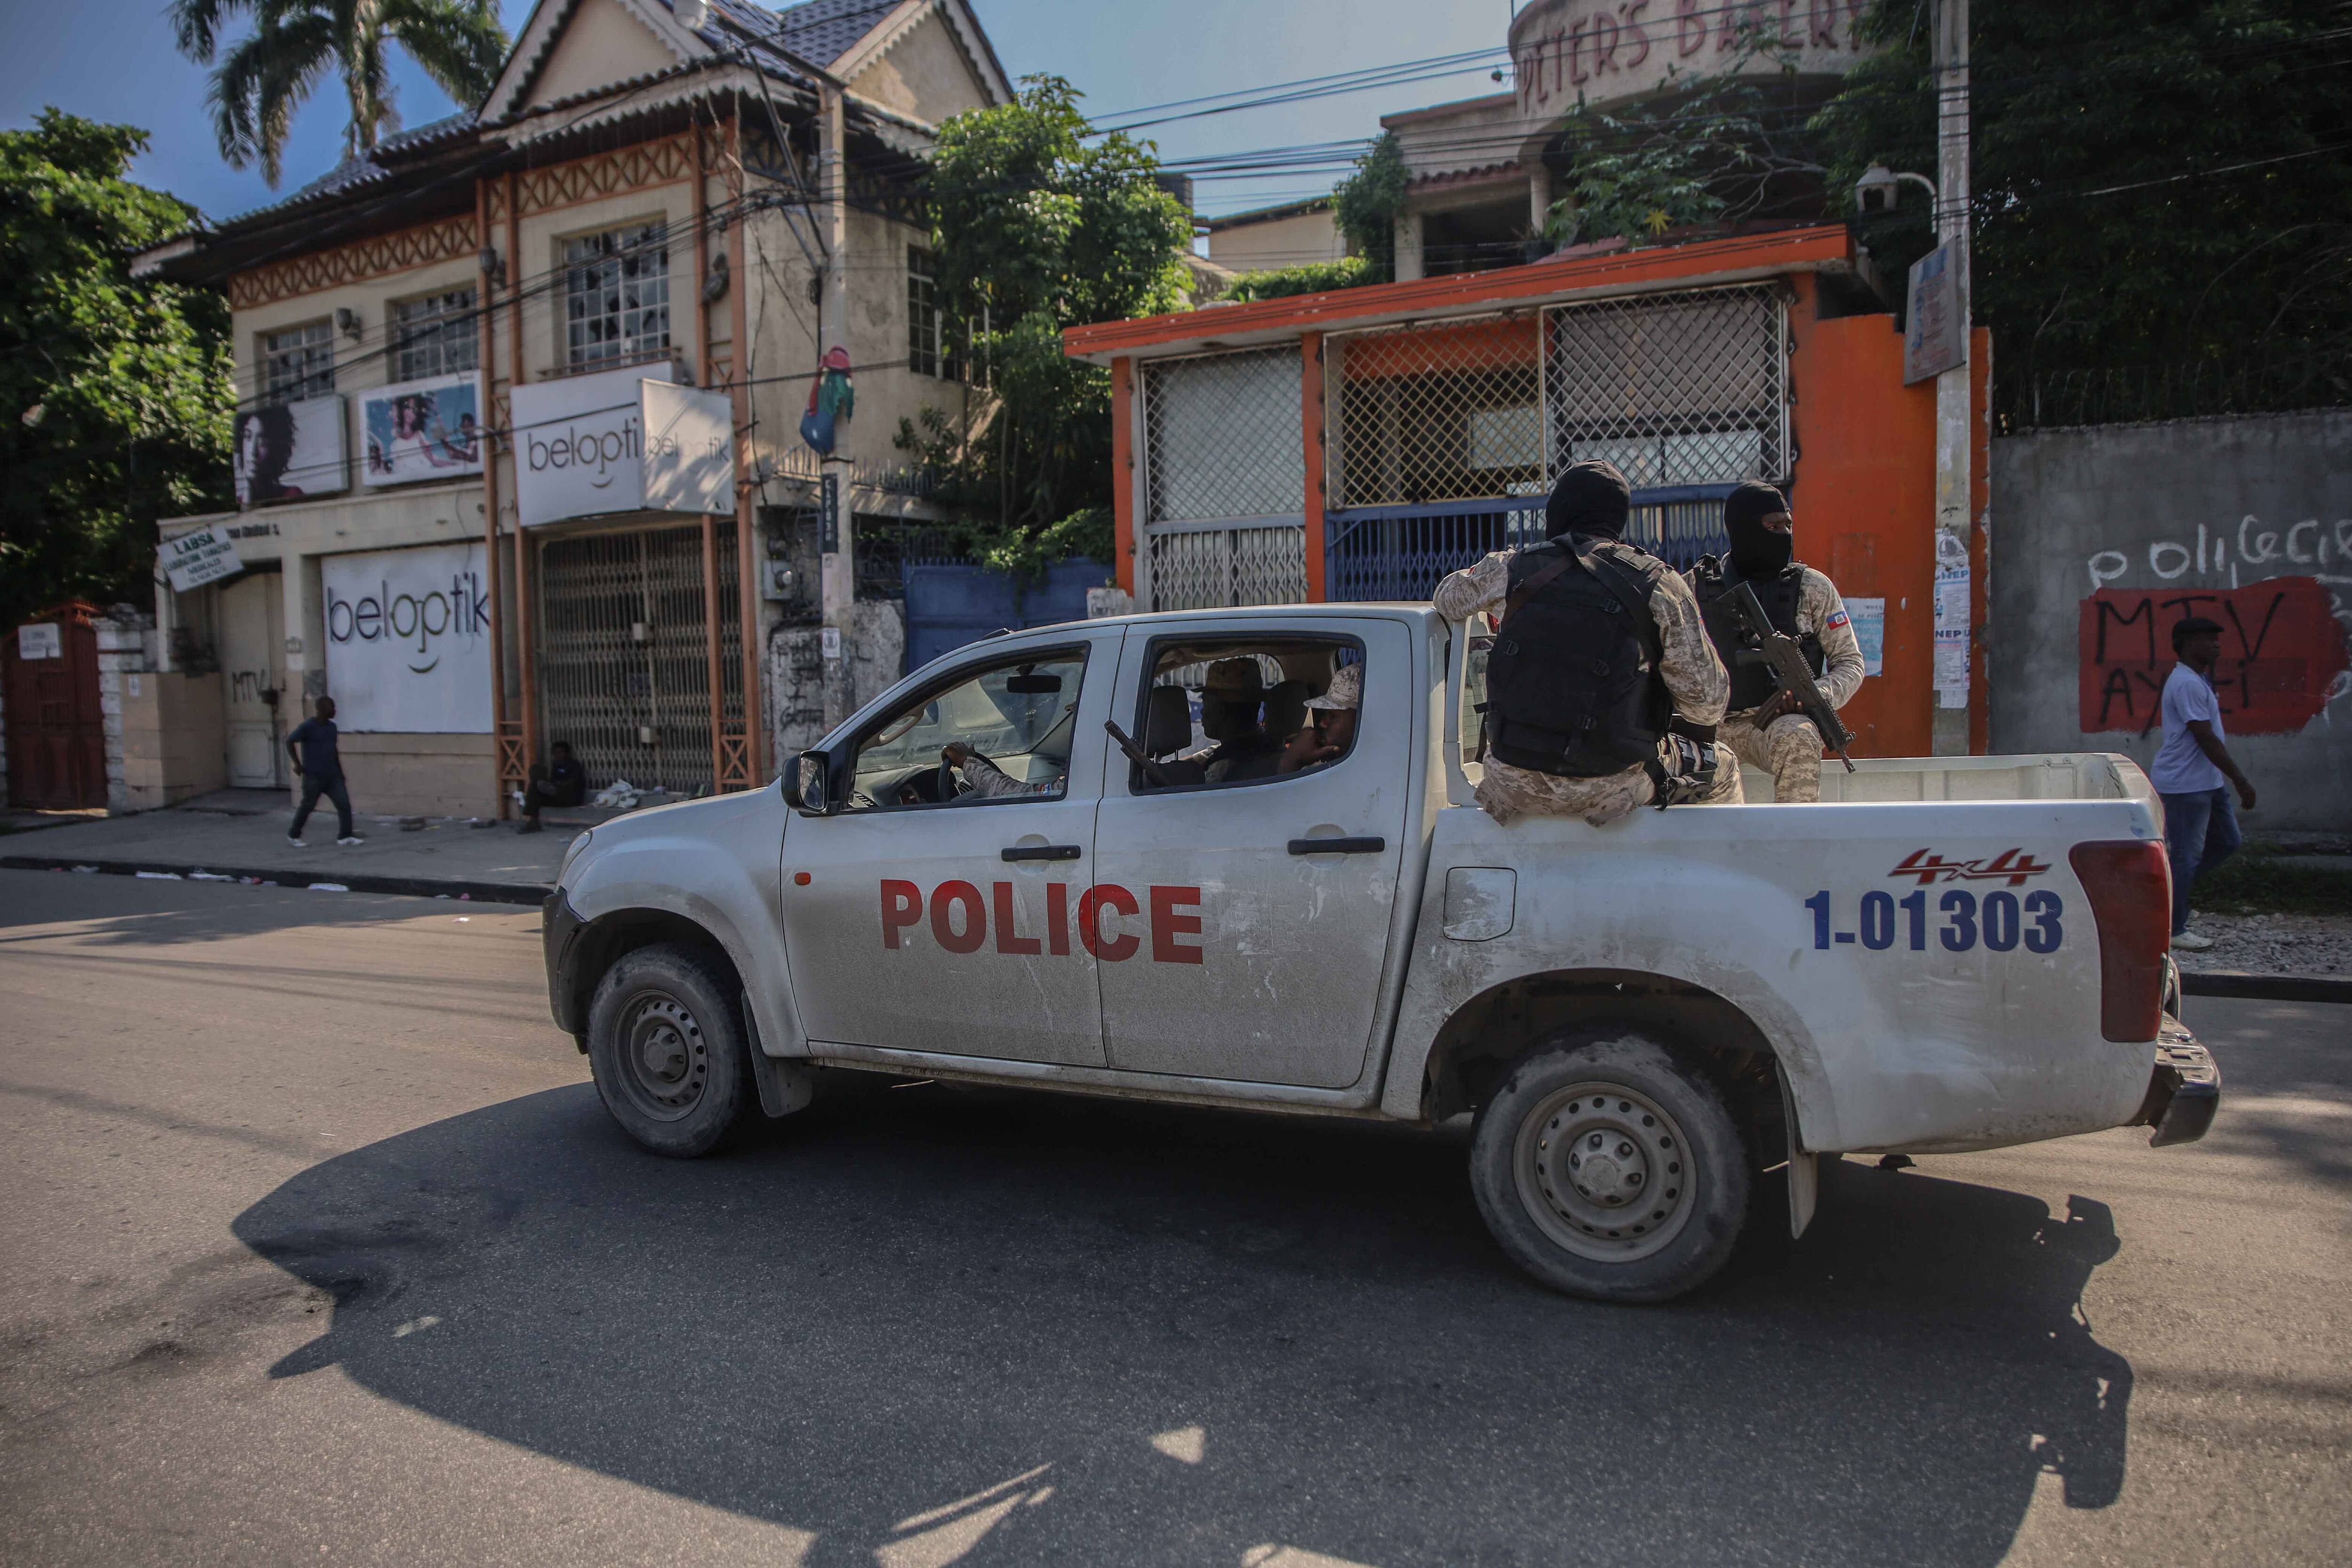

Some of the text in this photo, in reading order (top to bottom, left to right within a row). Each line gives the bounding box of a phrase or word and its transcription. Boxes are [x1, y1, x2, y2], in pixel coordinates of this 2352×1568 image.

[1523, 0, 1865, 114] PETER'S BAERY
[527, 418, 638, 474] belopti
[173, 532, 216, 555] LABSA
[327, 572, 490, 653] beloptik
[2095, 591, 2285, 670] MTV
[1887, 847, 2051, 886] 4x4
[880, 879, 1203, 965] POLICE
[1804, 890, 2063, 954] 1-01303
